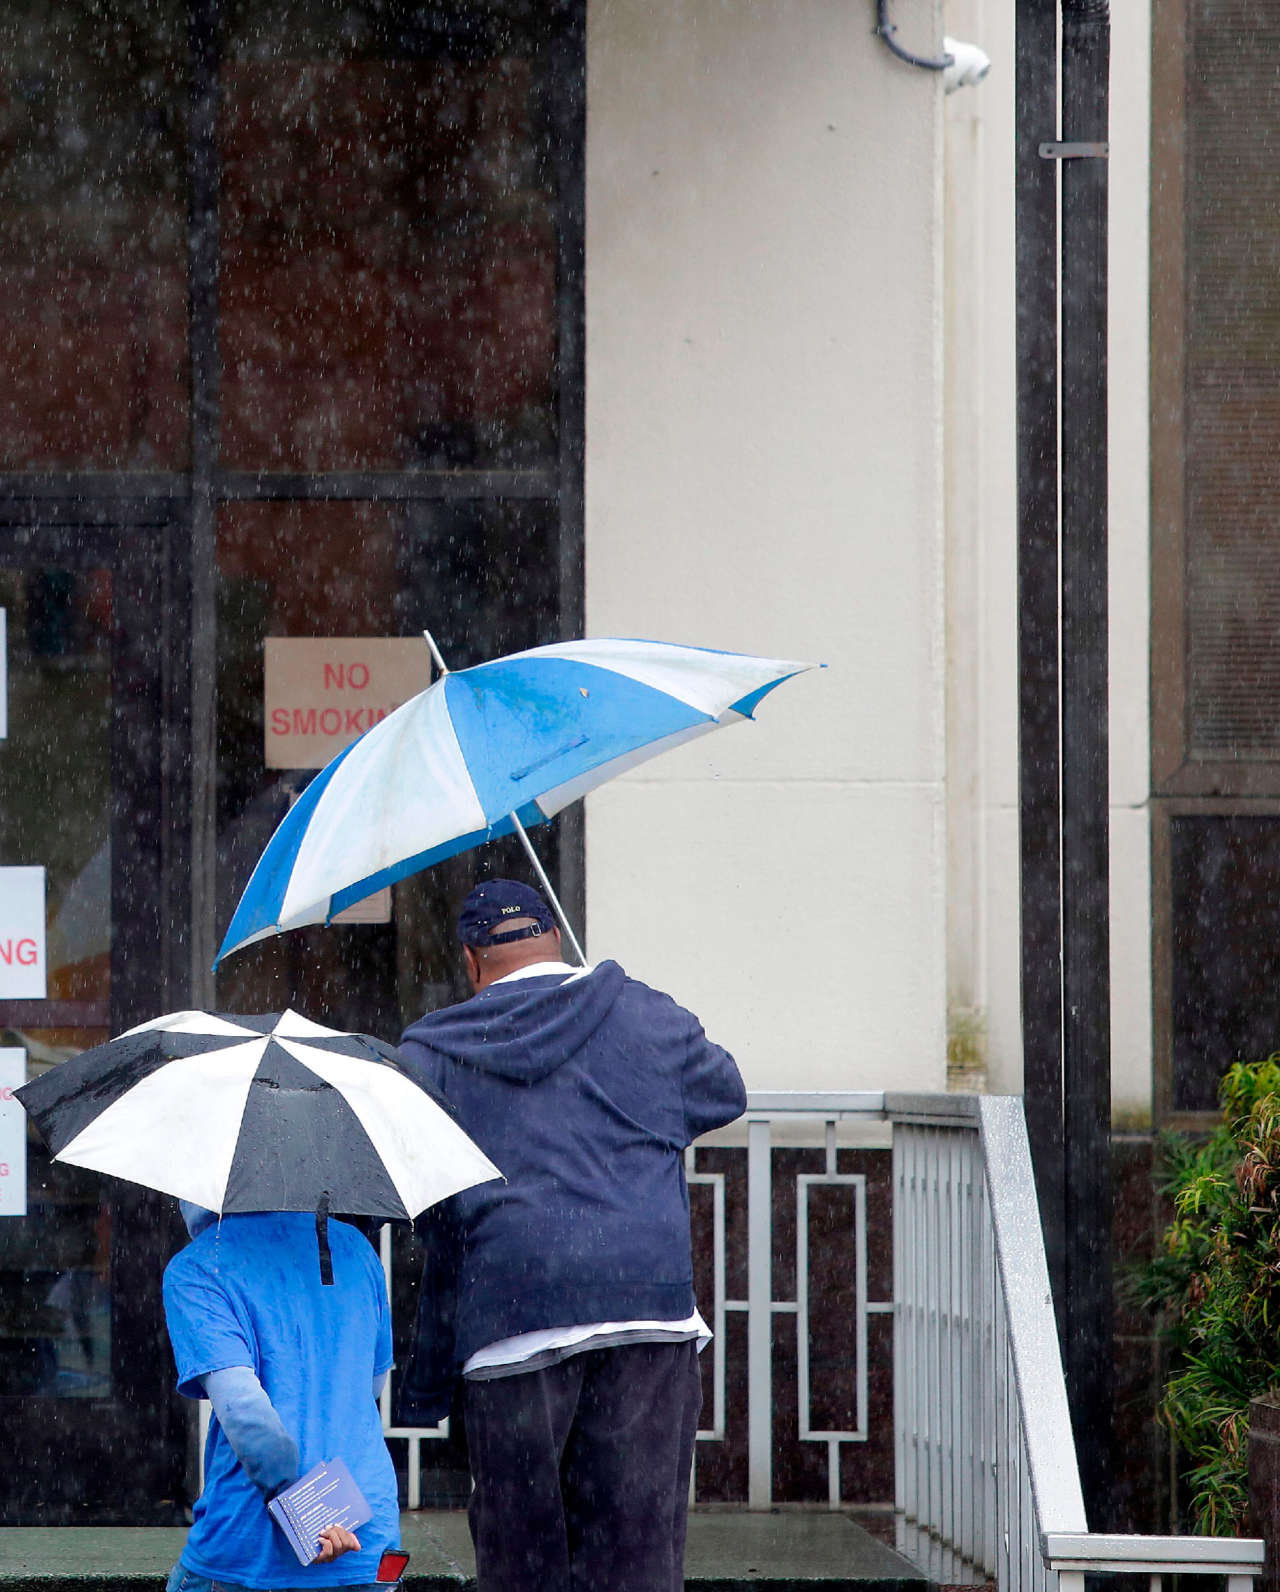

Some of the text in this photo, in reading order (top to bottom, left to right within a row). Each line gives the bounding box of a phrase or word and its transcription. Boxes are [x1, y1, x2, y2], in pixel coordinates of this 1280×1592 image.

[323, 663, 370, 691] NO
[271, 707, 386, 736] SMOKI
[501, 906, 521, 914] POLO
